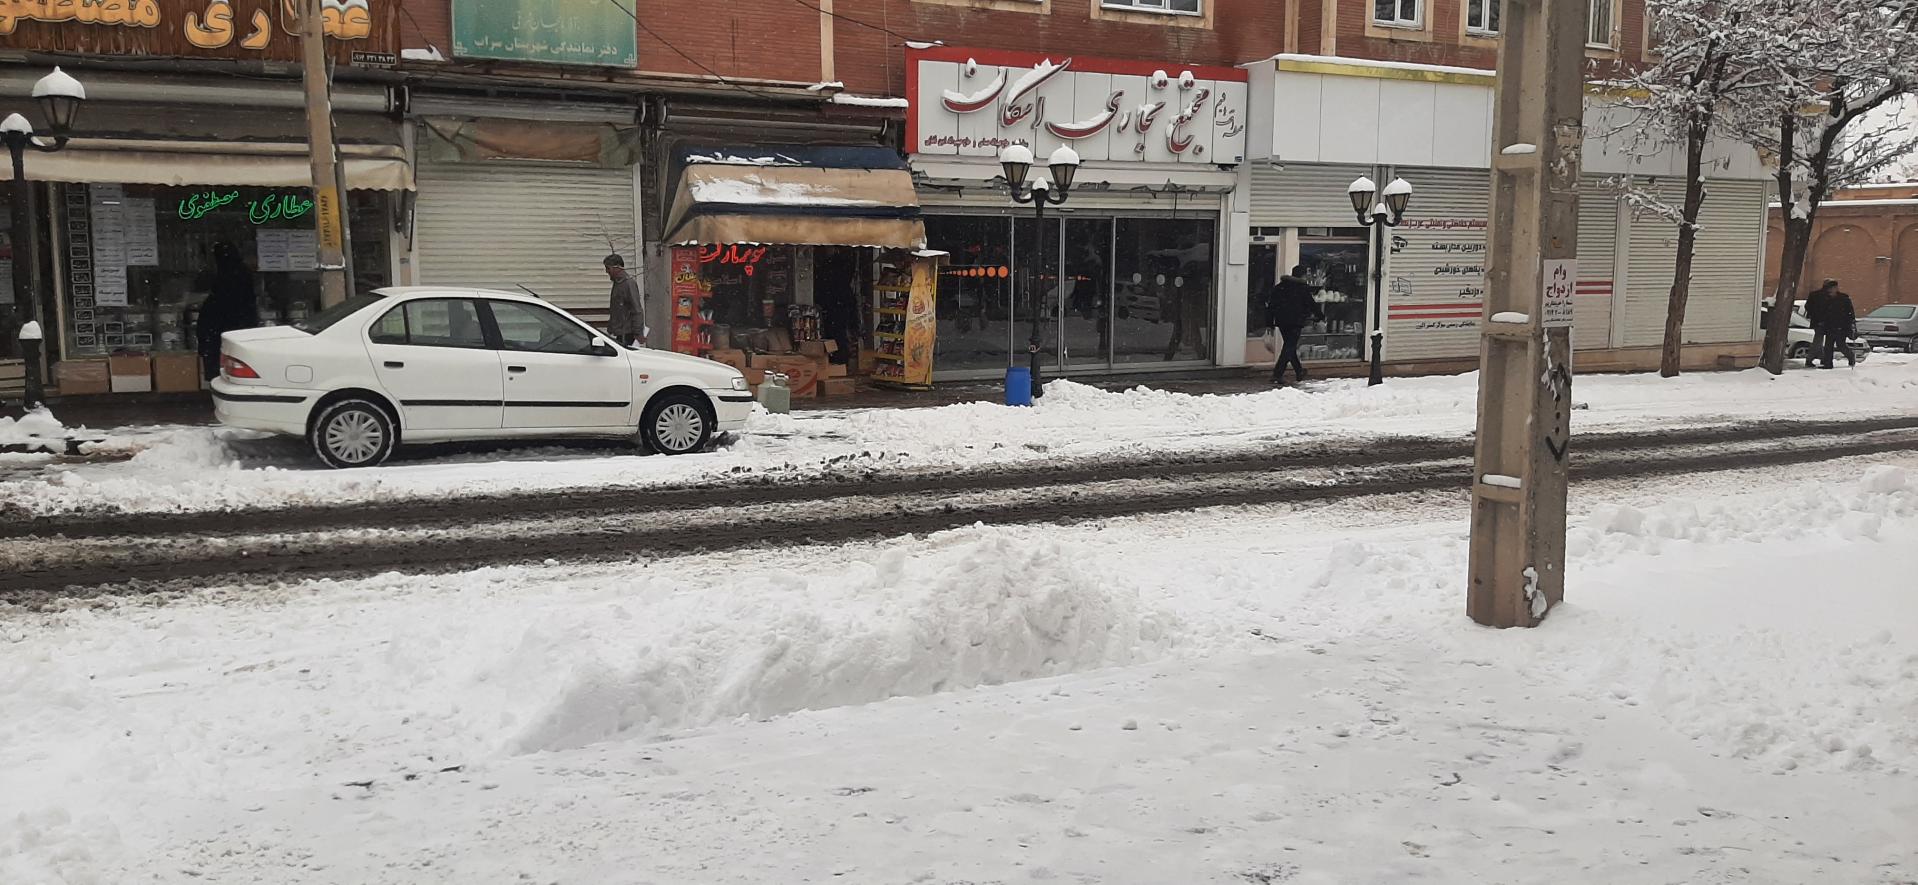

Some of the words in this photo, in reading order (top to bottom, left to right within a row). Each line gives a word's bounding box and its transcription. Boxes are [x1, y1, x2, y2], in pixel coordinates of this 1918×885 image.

[474, 35, 502, 49] سراب
[505, 37, 548, 52] شهرستان
[550, 41, 595, 54] نمایندگی
[598, 43, 618, 57] دفتر
[1045, 72, 1168, 155] تجاری
[1165, 71, 1212, 156] مجتمع
[178, 190, 239, 219] مصطفوی
[248, 193, 314, 225] عطاری
[1461, 243, 1482, 253] دوربین
[1553, 264, 1567, 281] وام
[1546, 281, 1573, 299] ازدواج
